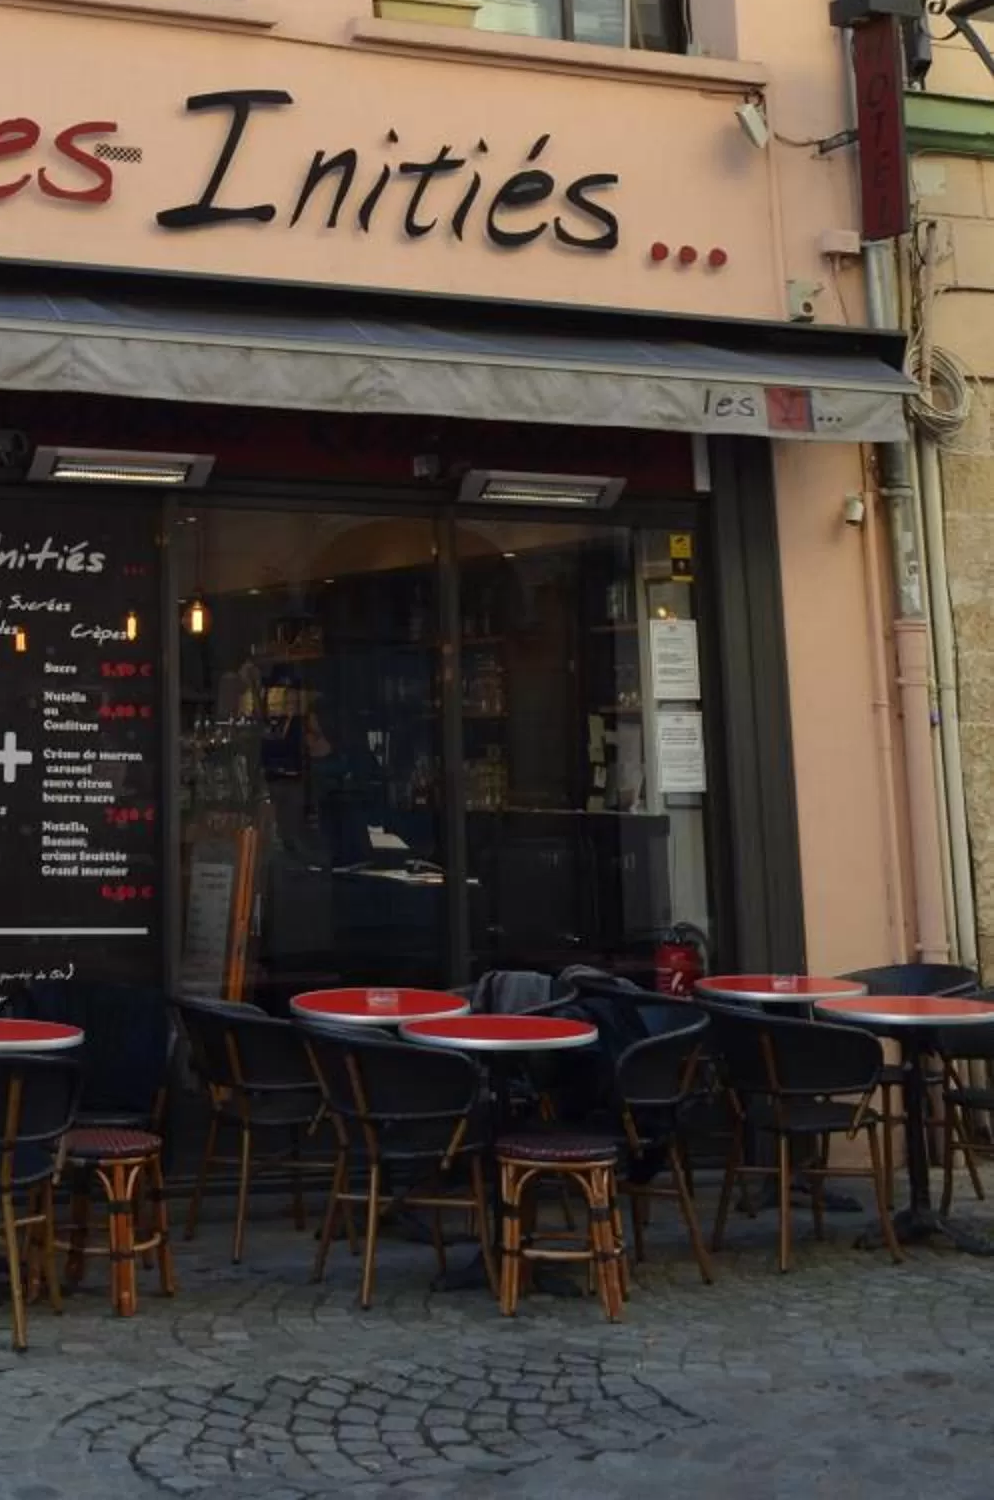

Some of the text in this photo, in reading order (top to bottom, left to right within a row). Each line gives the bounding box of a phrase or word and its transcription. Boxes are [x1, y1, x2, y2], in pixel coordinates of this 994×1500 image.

[156, 89, 619, 250] Initiés
[704, 388, 756, 417] les
[8, 594, 72, 612] Sucrées
[44, 662, 77, 674] Sucre
[44, 691, 87, 703] Nutella
[43, 719, 99, 731] Confiture
[83, 749, 97, 760] de
[77, 777, 113, 789] citron
[41, 865, 78, 876] Grand
